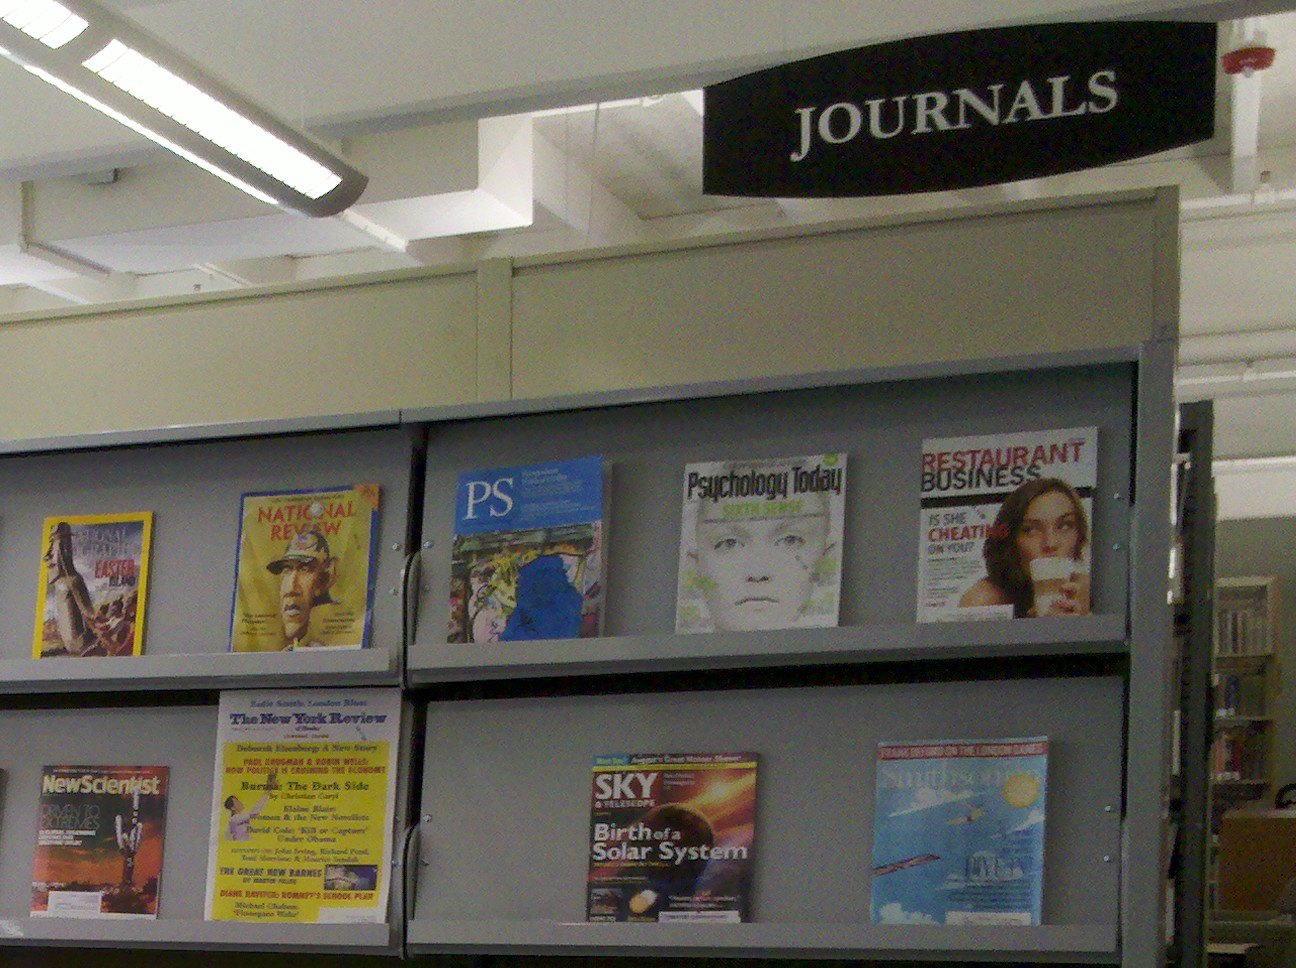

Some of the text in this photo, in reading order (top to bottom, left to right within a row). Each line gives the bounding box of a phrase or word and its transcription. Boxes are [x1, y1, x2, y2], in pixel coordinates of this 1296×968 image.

[790, 71, 1118, 162] JOURNALS
[921, 441, 1085, 472] RESTAURANT
[687, 464, 842, 502] Psychology Today
[921, 465, 1041, 492] BUSINESS
[462, 477, 514, 521] PS
[271, 520, 342, 541] REVEW
[95, 559, 135, 579] EASTER
[230, 713, 388, 725] The New York Review
[43, 775, 161, 795] NewScientist
[287, 781, 308, 791] The
[312, 781, 341, 791] Dark
[595, 772, 659, 800] SKY
[594, 822, 682, 841] Birth of a
[592, 841, 748, 865] Solar System
